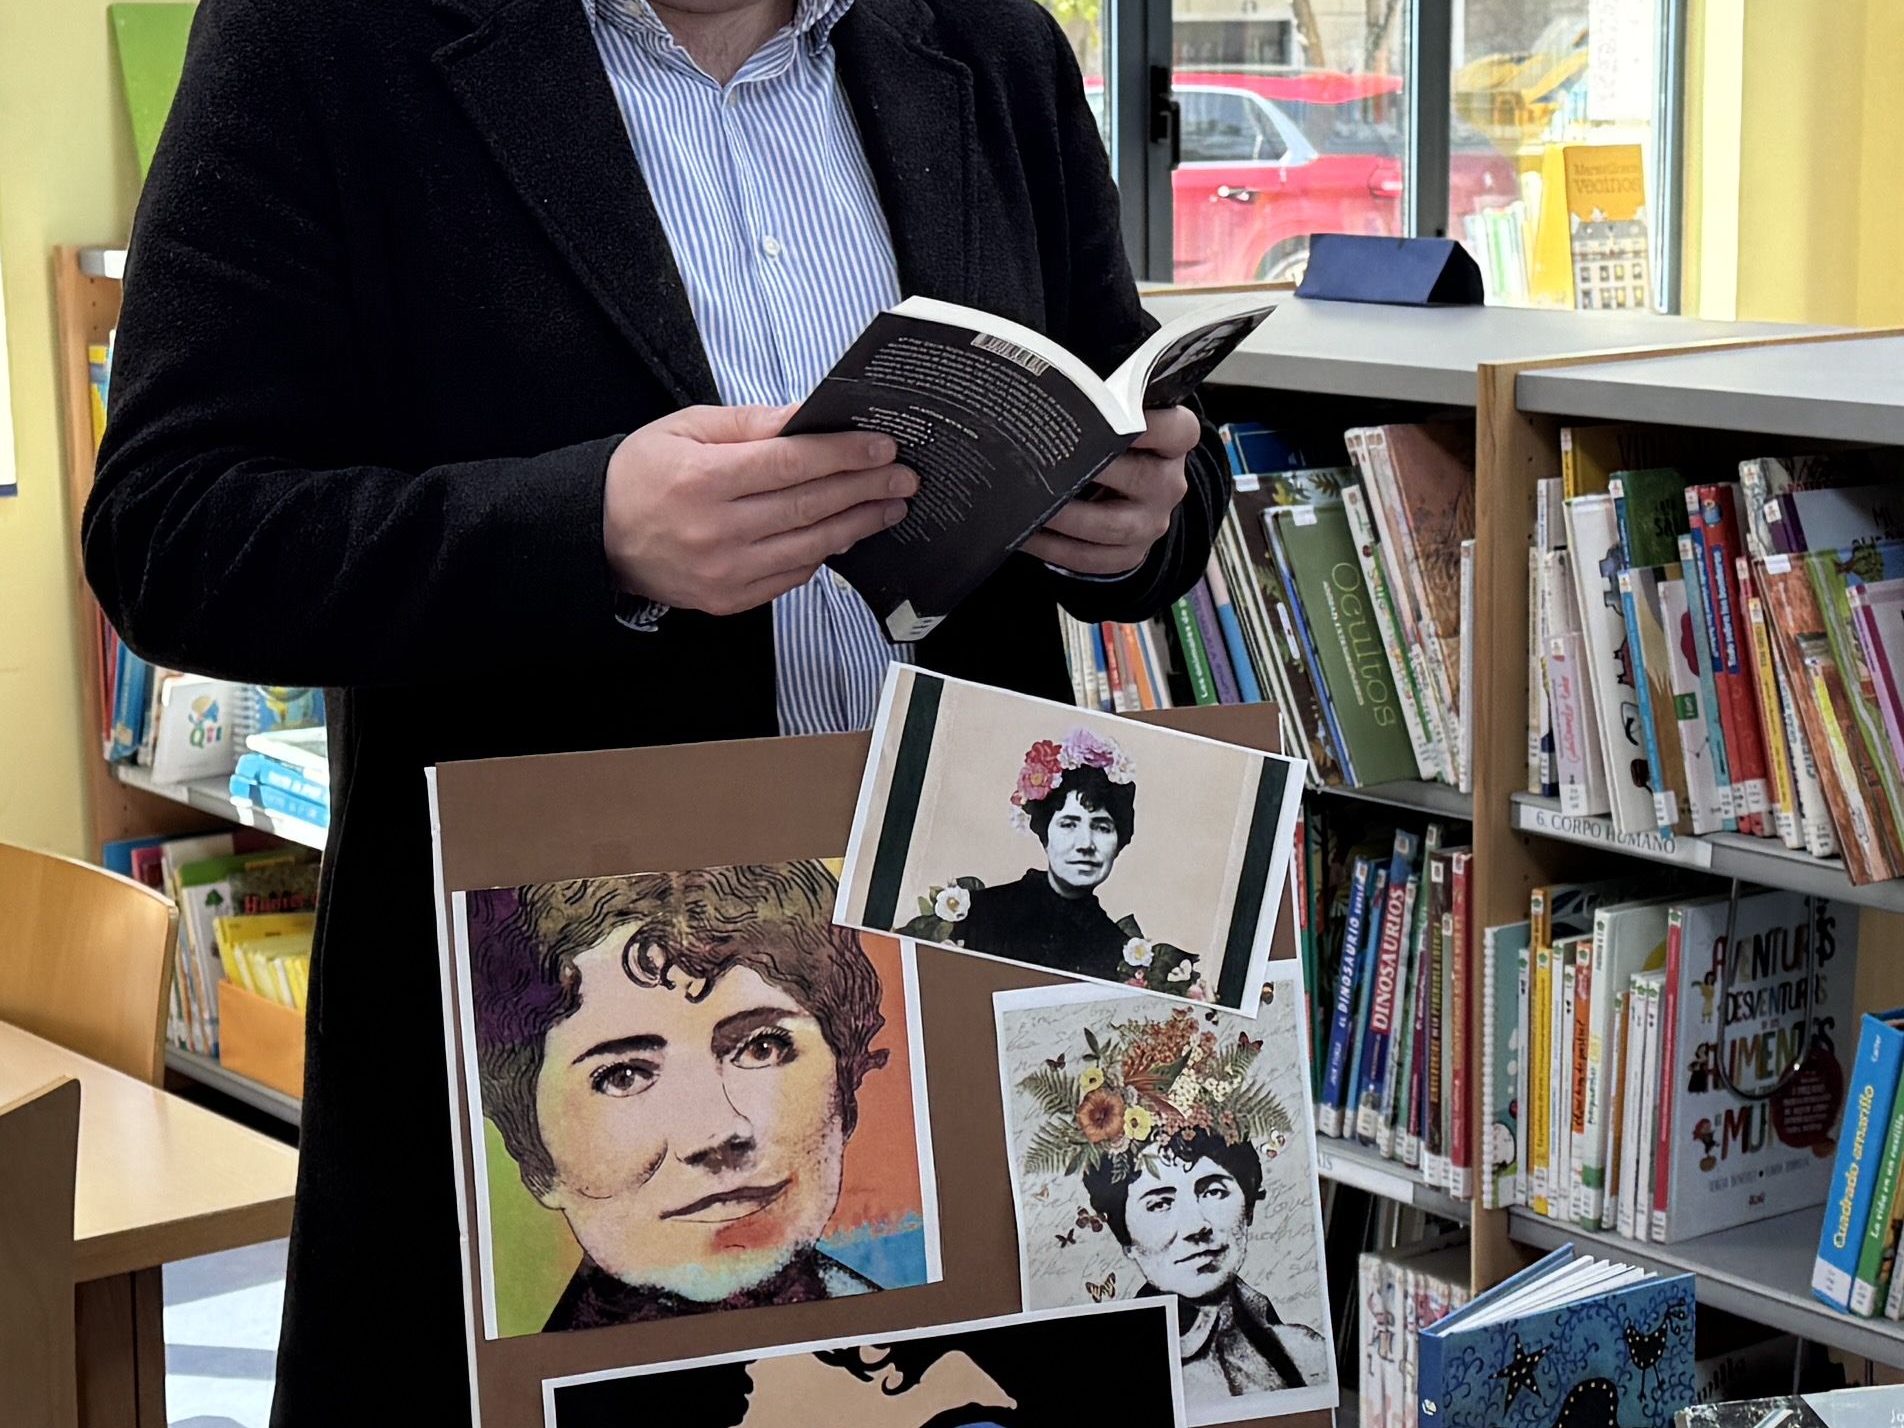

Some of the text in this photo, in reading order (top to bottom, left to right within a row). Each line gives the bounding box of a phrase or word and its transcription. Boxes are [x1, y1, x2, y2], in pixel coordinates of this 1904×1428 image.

[1331, 561, 1395, 728] Ocultos
[1537, 810, 1675, 855] 6. CORPO HUMANO
[1371, 886, 1405, 1033] DINOSAURIOS
